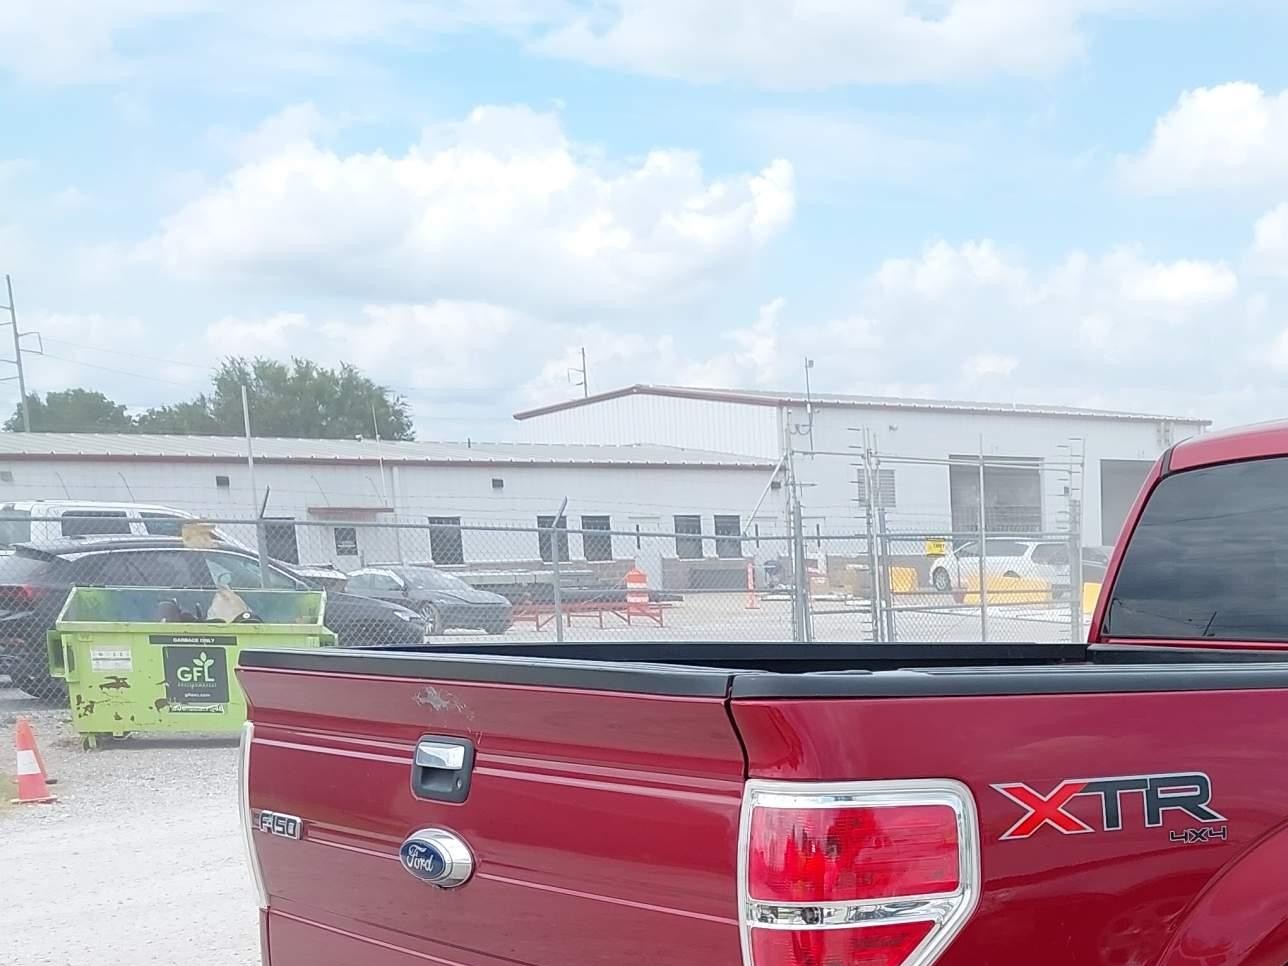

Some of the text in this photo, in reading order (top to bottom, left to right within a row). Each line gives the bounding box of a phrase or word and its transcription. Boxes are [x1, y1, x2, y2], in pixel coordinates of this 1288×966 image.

[177, 661, 215, 682] GFL
[989, 772, 1228, 840] XTR
[259, 811, 299, 838] F-150
[405, 844, 434, 872] Ford
